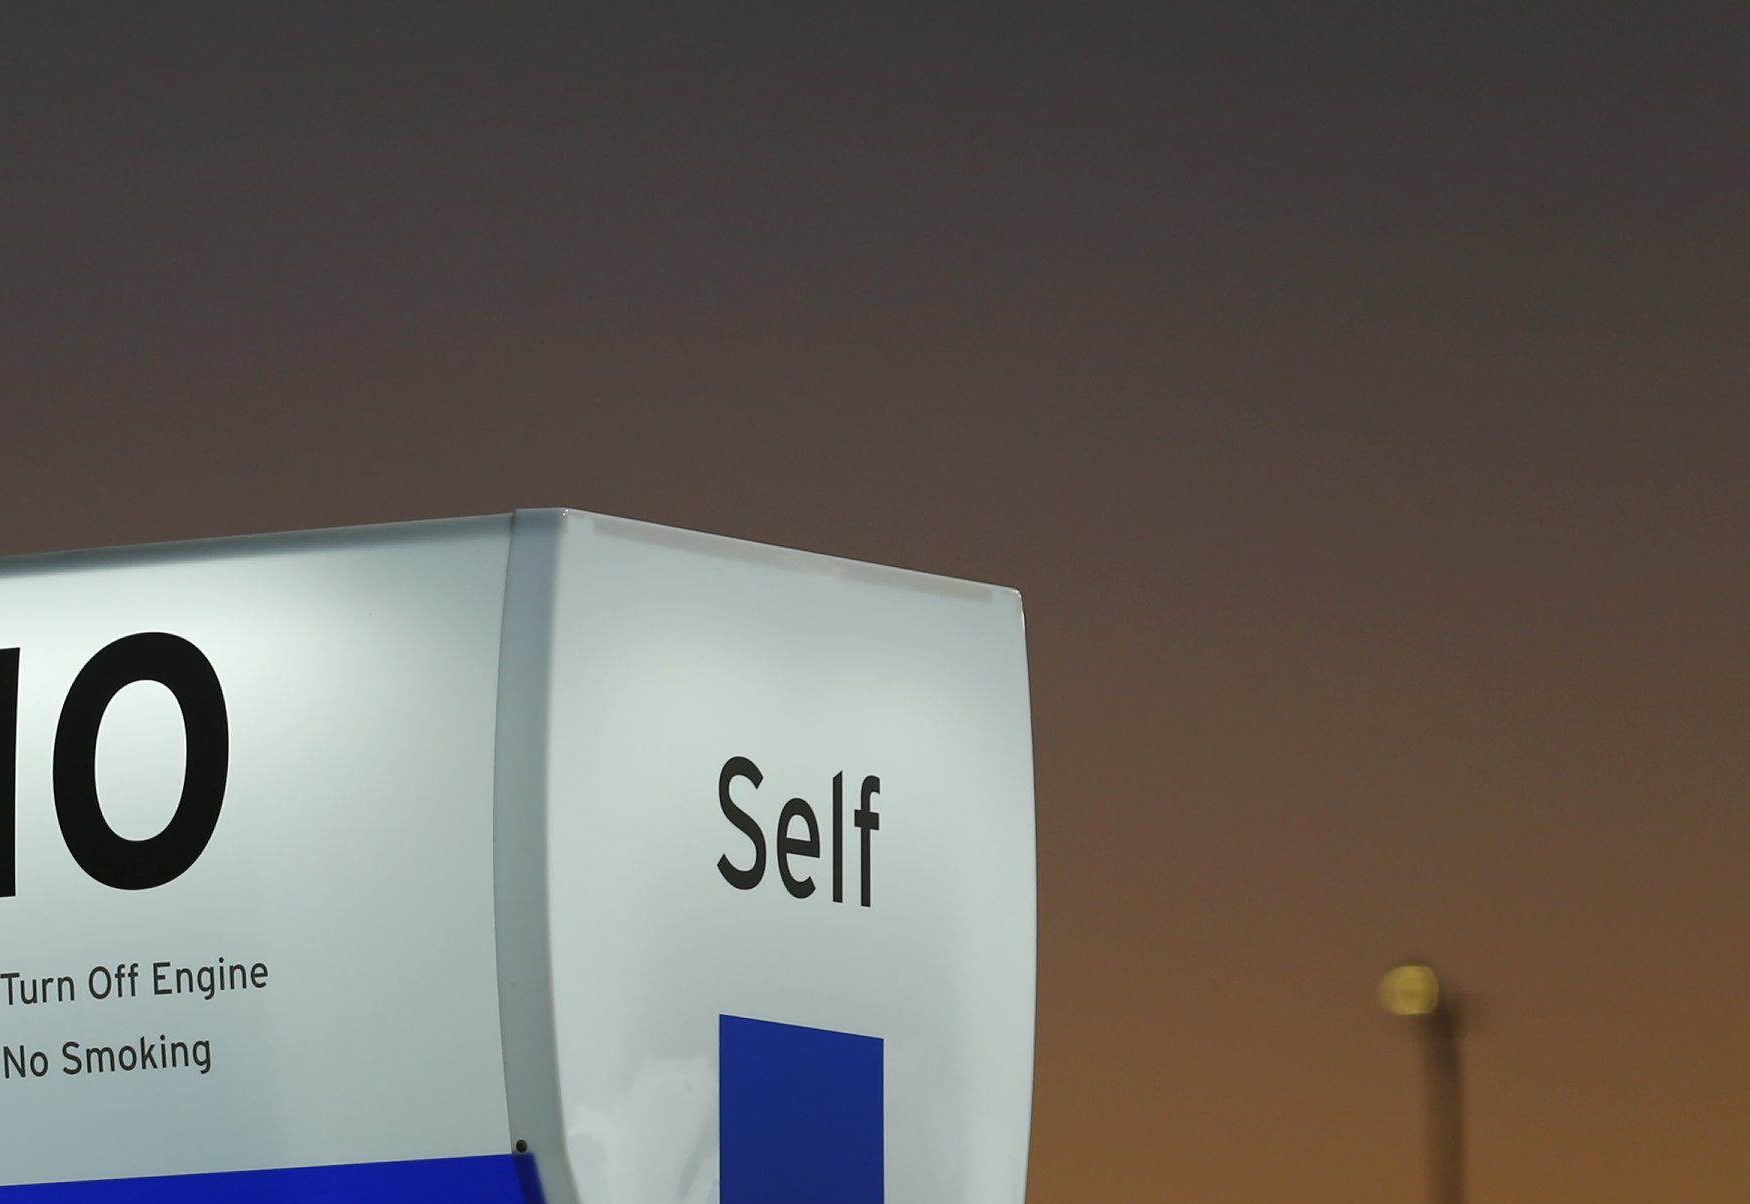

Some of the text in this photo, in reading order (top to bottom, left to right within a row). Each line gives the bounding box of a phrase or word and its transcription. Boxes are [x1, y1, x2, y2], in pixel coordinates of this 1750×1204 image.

[717, 756, 880, 907] Self
[0, 957, 268, 1005] Turn Off Engine
[3, 1034, 211, 1079] No Smoking
